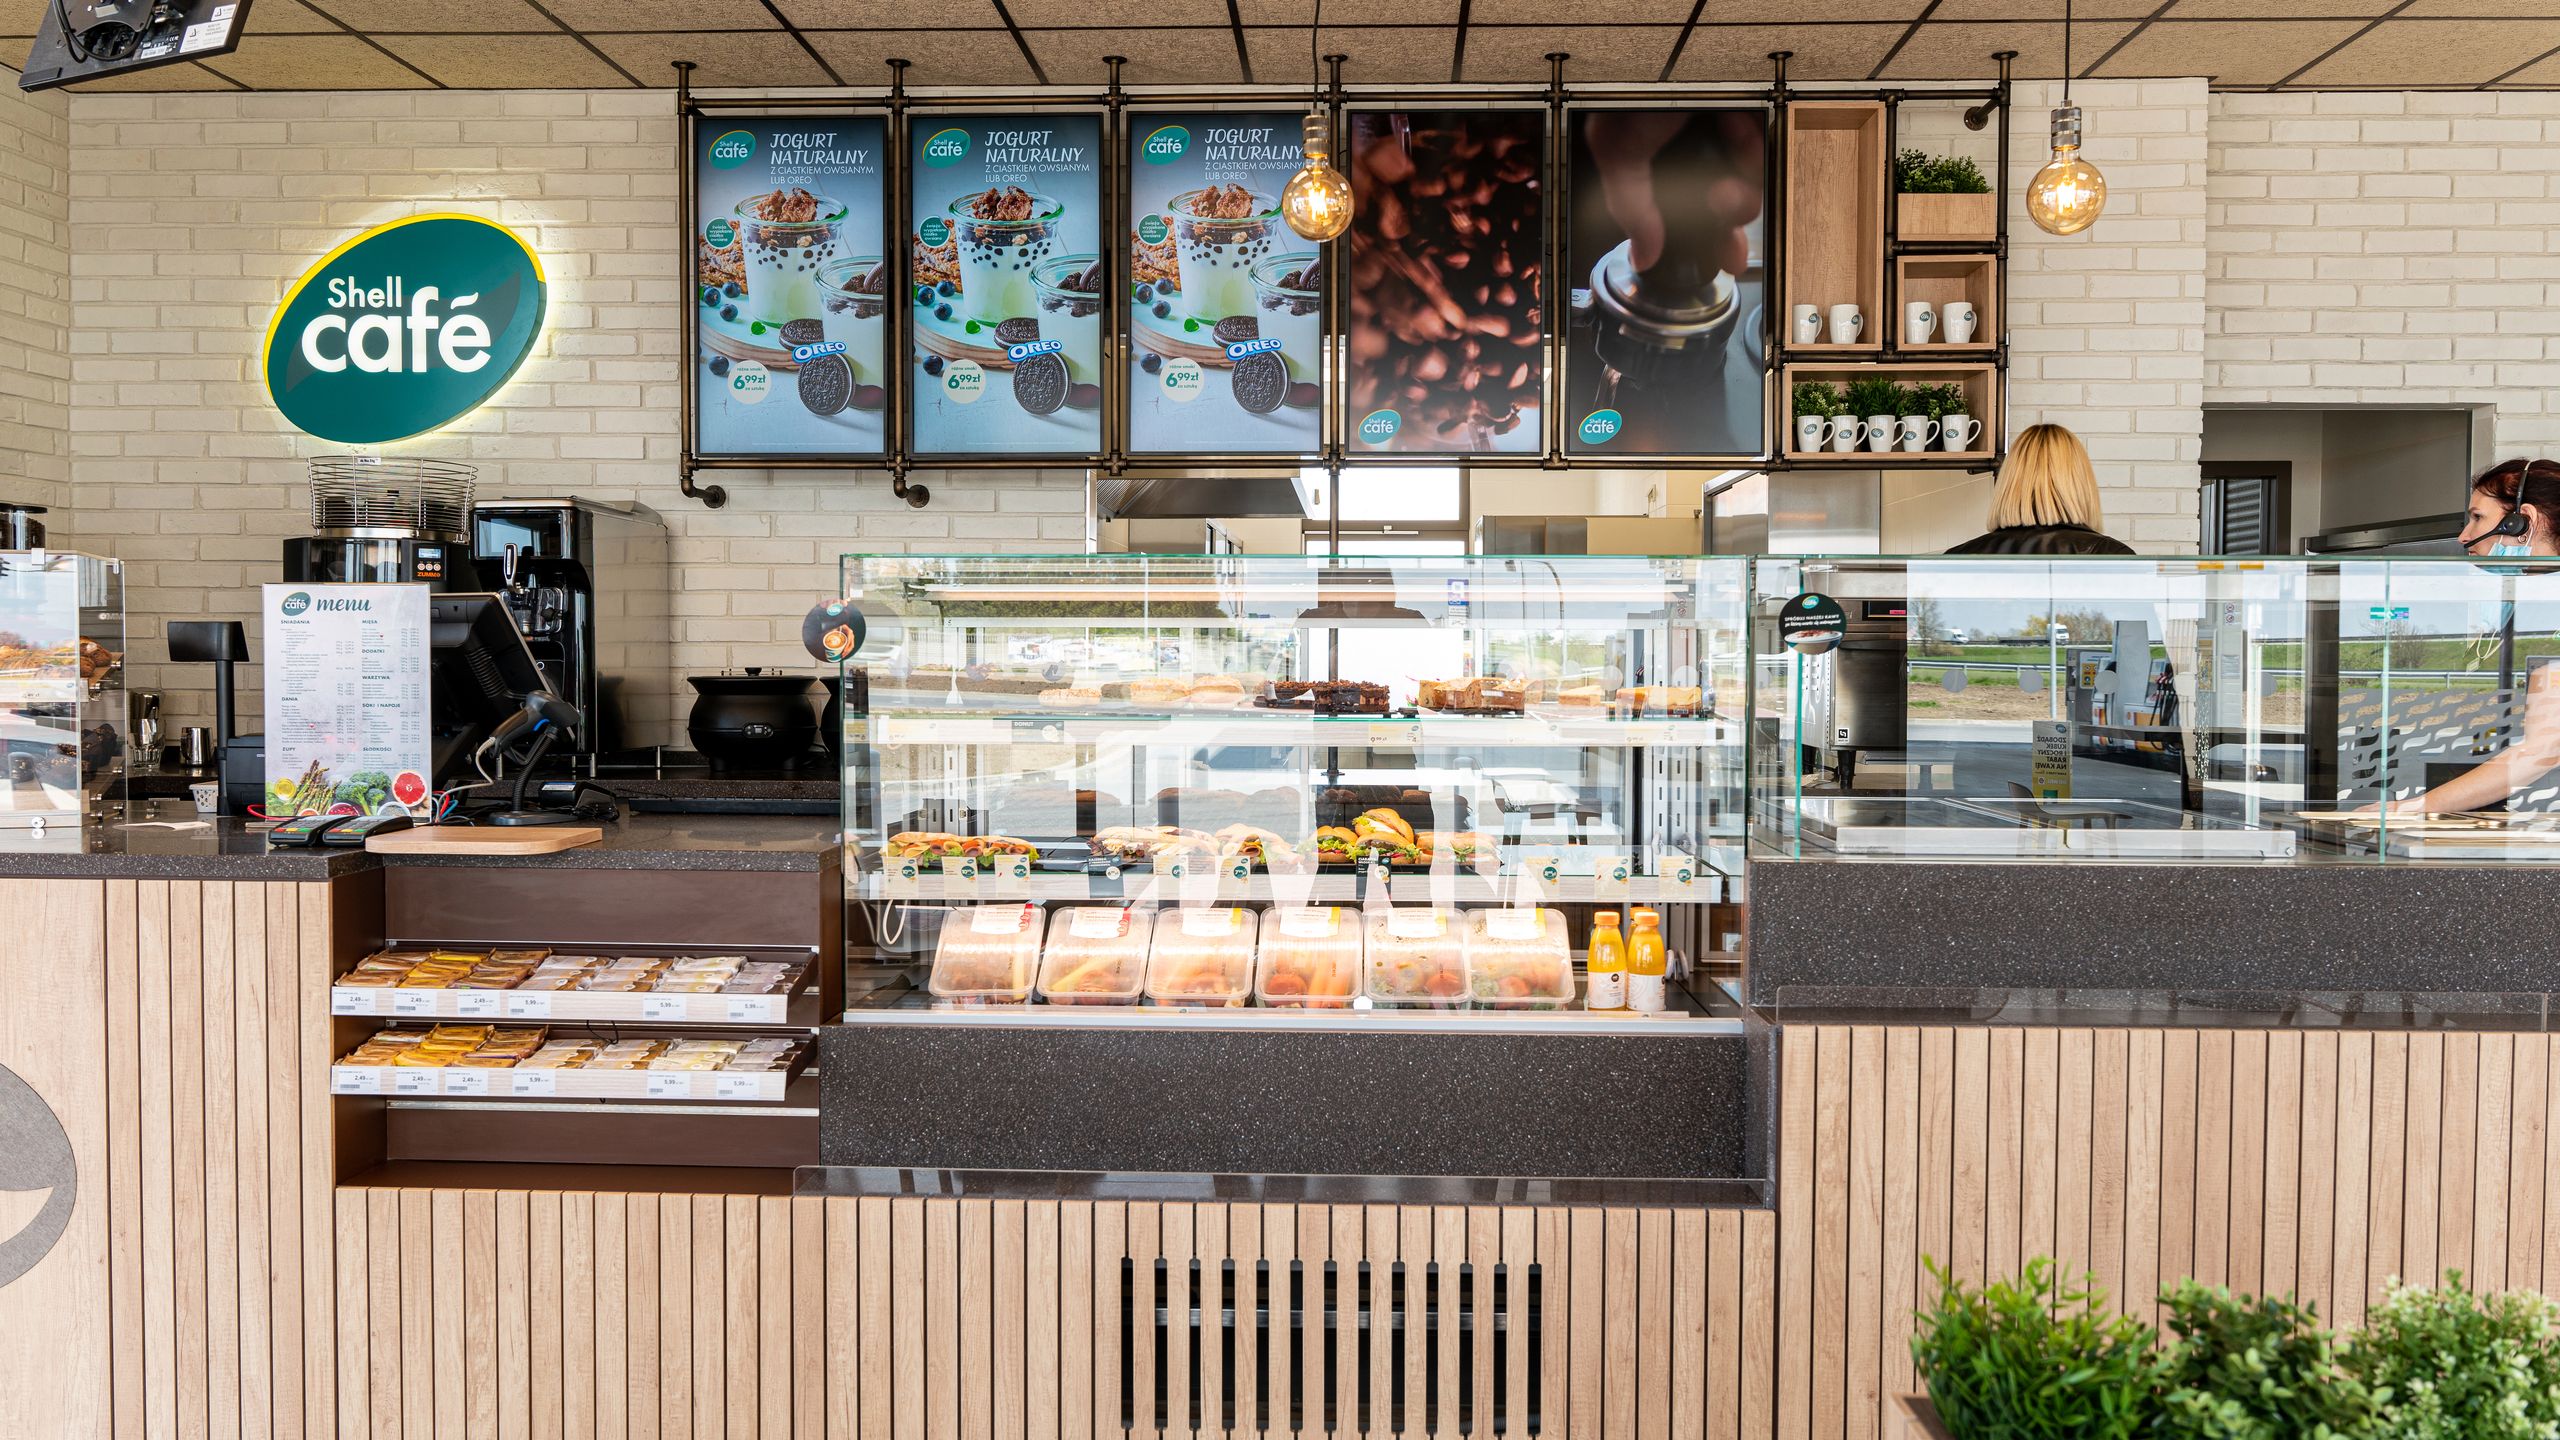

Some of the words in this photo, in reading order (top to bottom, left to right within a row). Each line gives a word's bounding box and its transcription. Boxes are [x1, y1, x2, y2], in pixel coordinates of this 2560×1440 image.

[770, 133, 837, 150] JOGURT
[985, 131, 1052, 147] JOGURT
[1205, 128, 1273, 145] JOGURT
[715, 143, 748, 158] café
[929, 141, 963, 157] café
[1149, 138, 1182, 153] café
[770, 150, 868, 165] NATURALNY
[985, 148, 1084, 163] NATURALNY
[1205, 146, 1303, 161] NATURALNY
[771, 167, 776, 175] Z
[778, 167, 822, 175] CIASTKIEM
[823, 166, 873, 174] OWSIANYM
[985, 165, 991, 173] Z
[993, 165, 1037, 173] CIASTKIEM
[1039, 164, 1090, 172] OWSIANYM
[1205, 162, 1211, 170] Z
[1213, 162, 1256, 170] CIASTKIEM
[1259, 162, 1306, 170] OWSIANY
[771, 176, 786, 184] LUB
[787, 176, 812, 184] OREO
[985, 174, 1000, 182] LUB
[1002, 174, 1027, 182] OREO
[1205, 172, 1220, 180] LUB
[1222, 172, 1247, 180] OREO
[328, 275, 402, 308] Shell
[301, 286, 491, 373] café
[795, 342, 846, 360] OREO
[1010, 341, 1061, 359] OREO
[1228, 339, 1280, 358] OREO
[1364, 420, 1393, 433] café
[1585, 420, 1615, 433] café
[285, 599, 306, 609] café
[317, 598, 371, 611] menu
